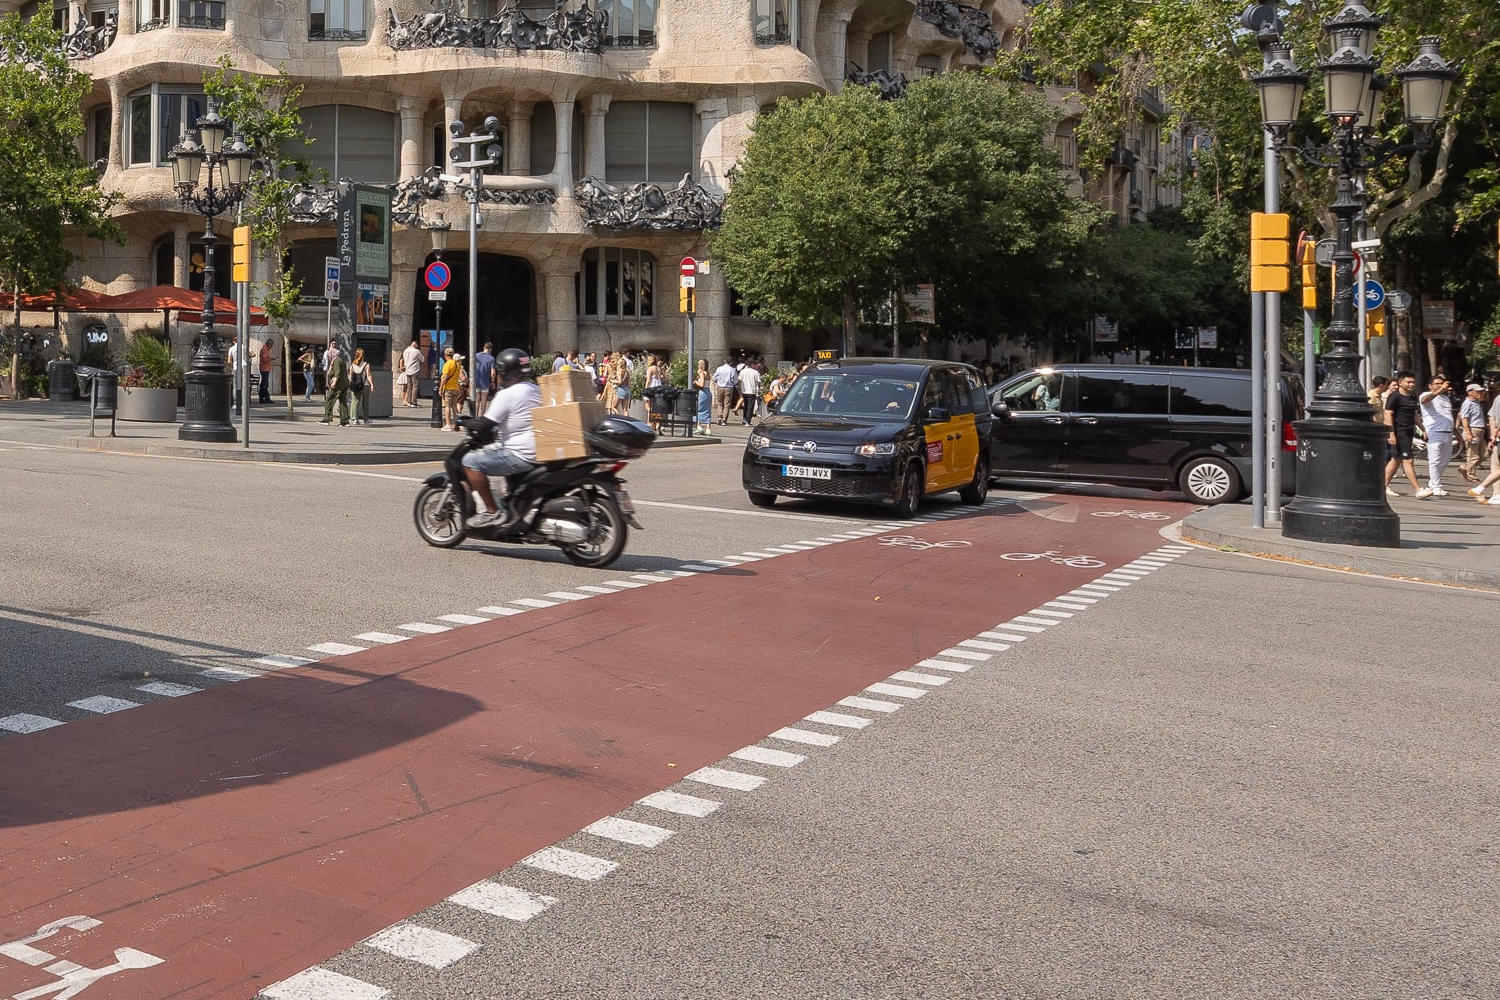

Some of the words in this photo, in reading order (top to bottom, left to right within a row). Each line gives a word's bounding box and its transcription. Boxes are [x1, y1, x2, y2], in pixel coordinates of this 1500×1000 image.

[340, 209, 351, 255] Pedrera
[818, 351, 832, 359] TAXI
[788, 466, 809, 477] 5791
[812, 467, 829, 478] MVX
